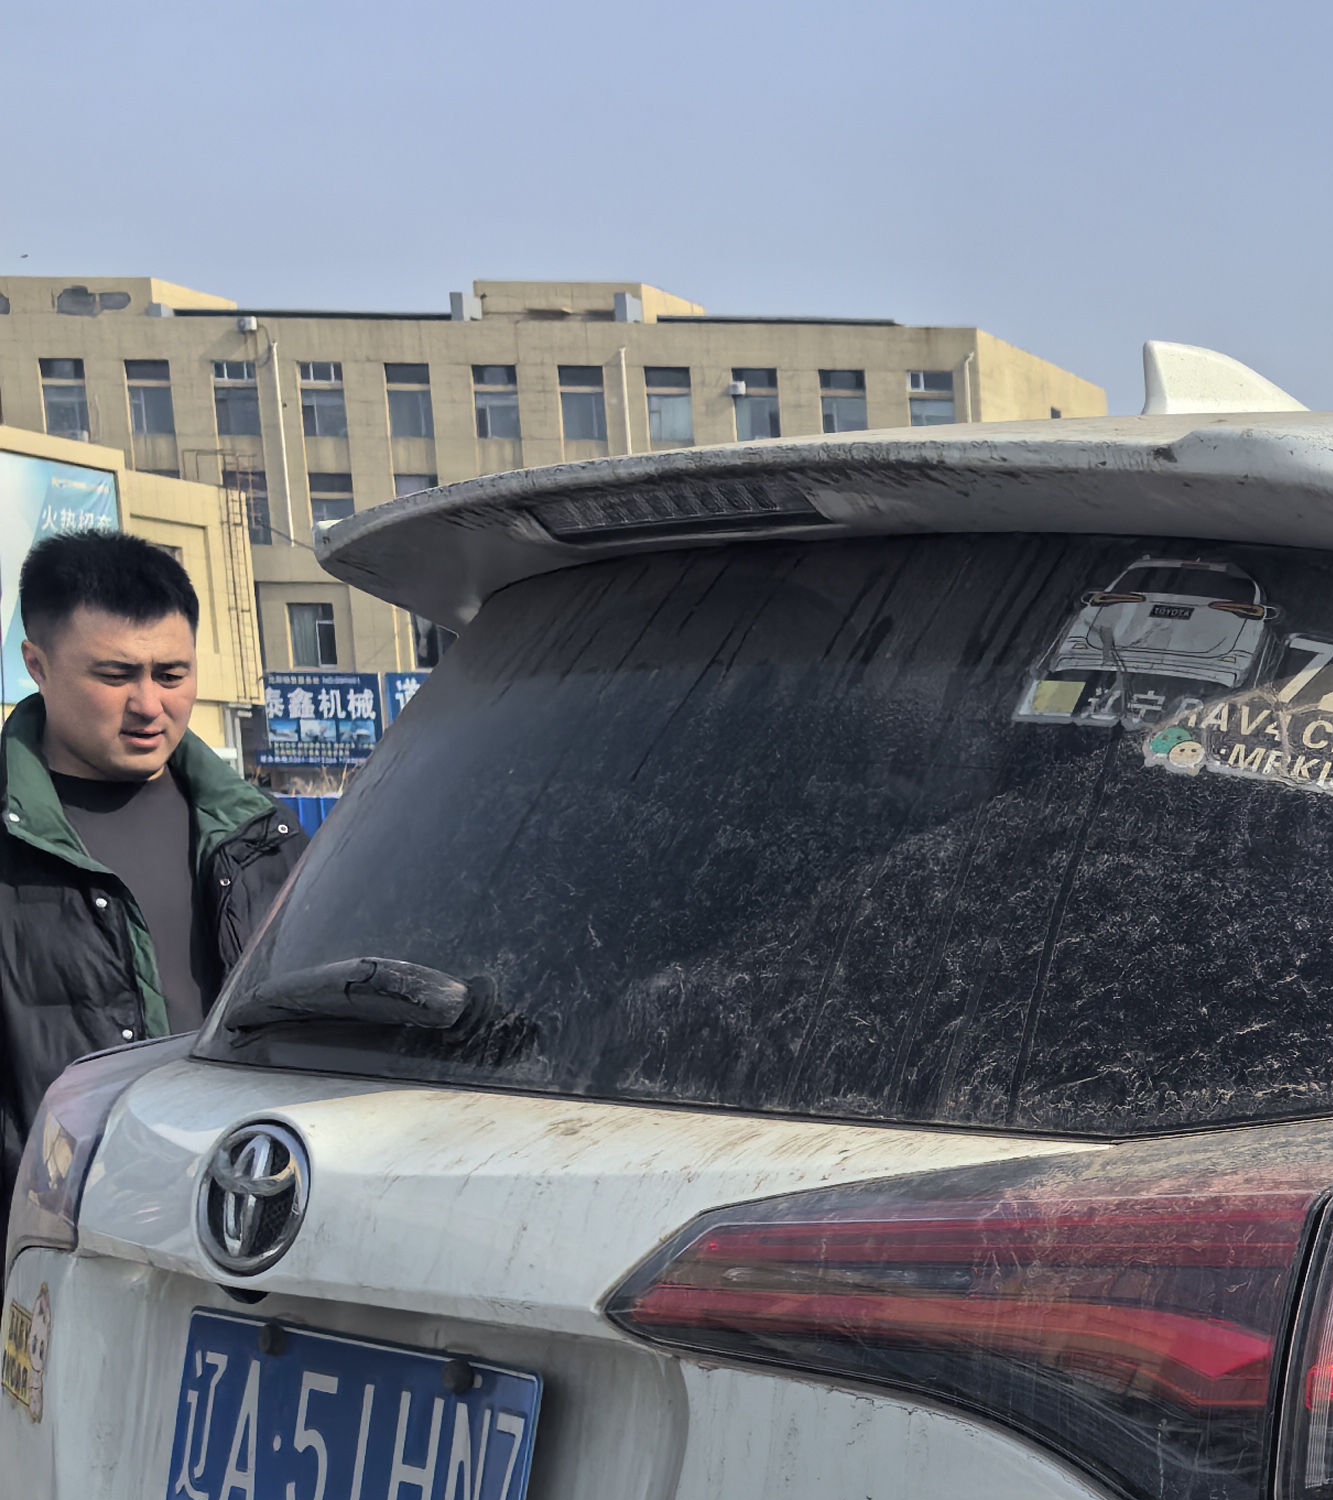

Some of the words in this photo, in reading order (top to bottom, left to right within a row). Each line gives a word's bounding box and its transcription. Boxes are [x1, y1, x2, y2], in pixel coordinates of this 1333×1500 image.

[265, 686, 377, 720] 泰鑫机械
[1175, 697, 1291, 742] RAV4
